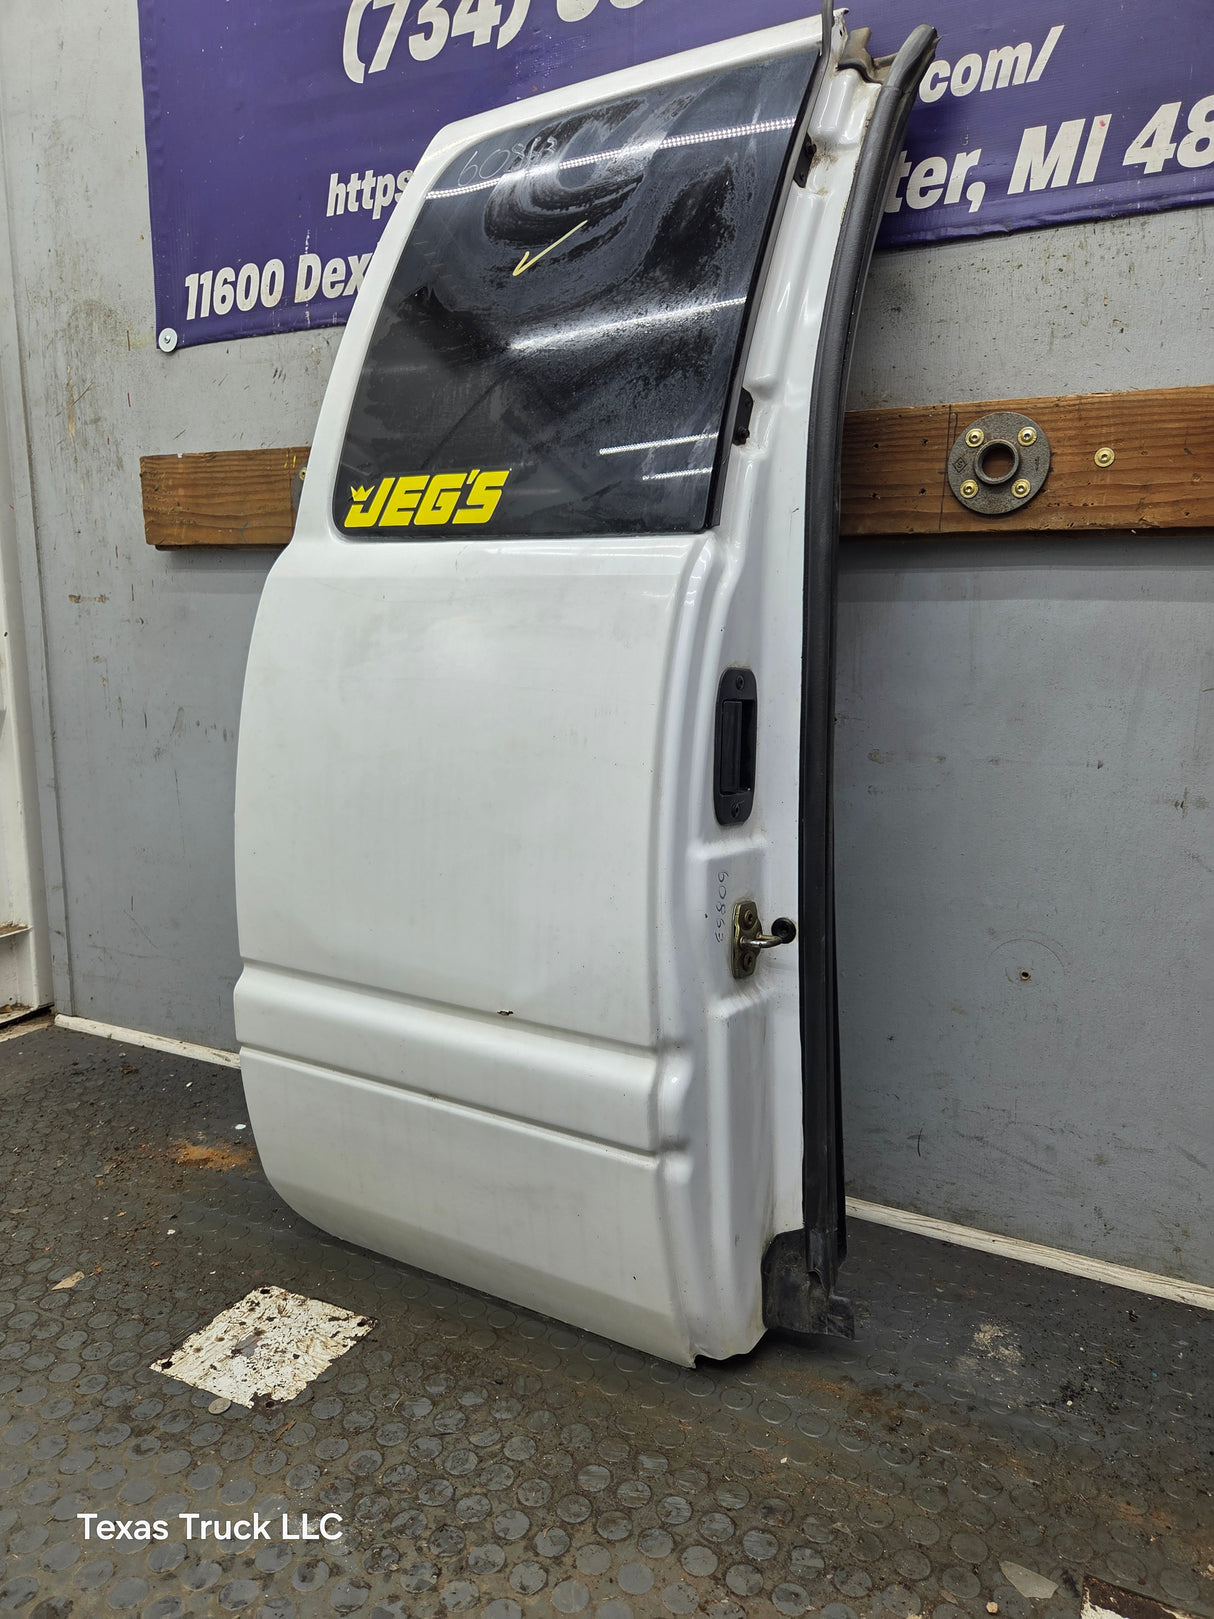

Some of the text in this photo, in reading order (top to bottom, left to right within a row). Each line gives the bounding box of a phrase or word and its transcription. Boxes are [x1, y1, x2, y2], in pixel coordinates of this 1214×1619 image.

[185, 258, 285, 321] 11600
[294, 253, 373, 303] Dex
[1007, 114, 1113, 195] MI
[1122, 95, 1214, 174] 48
[344, 469, 510, 528] JEG'S
